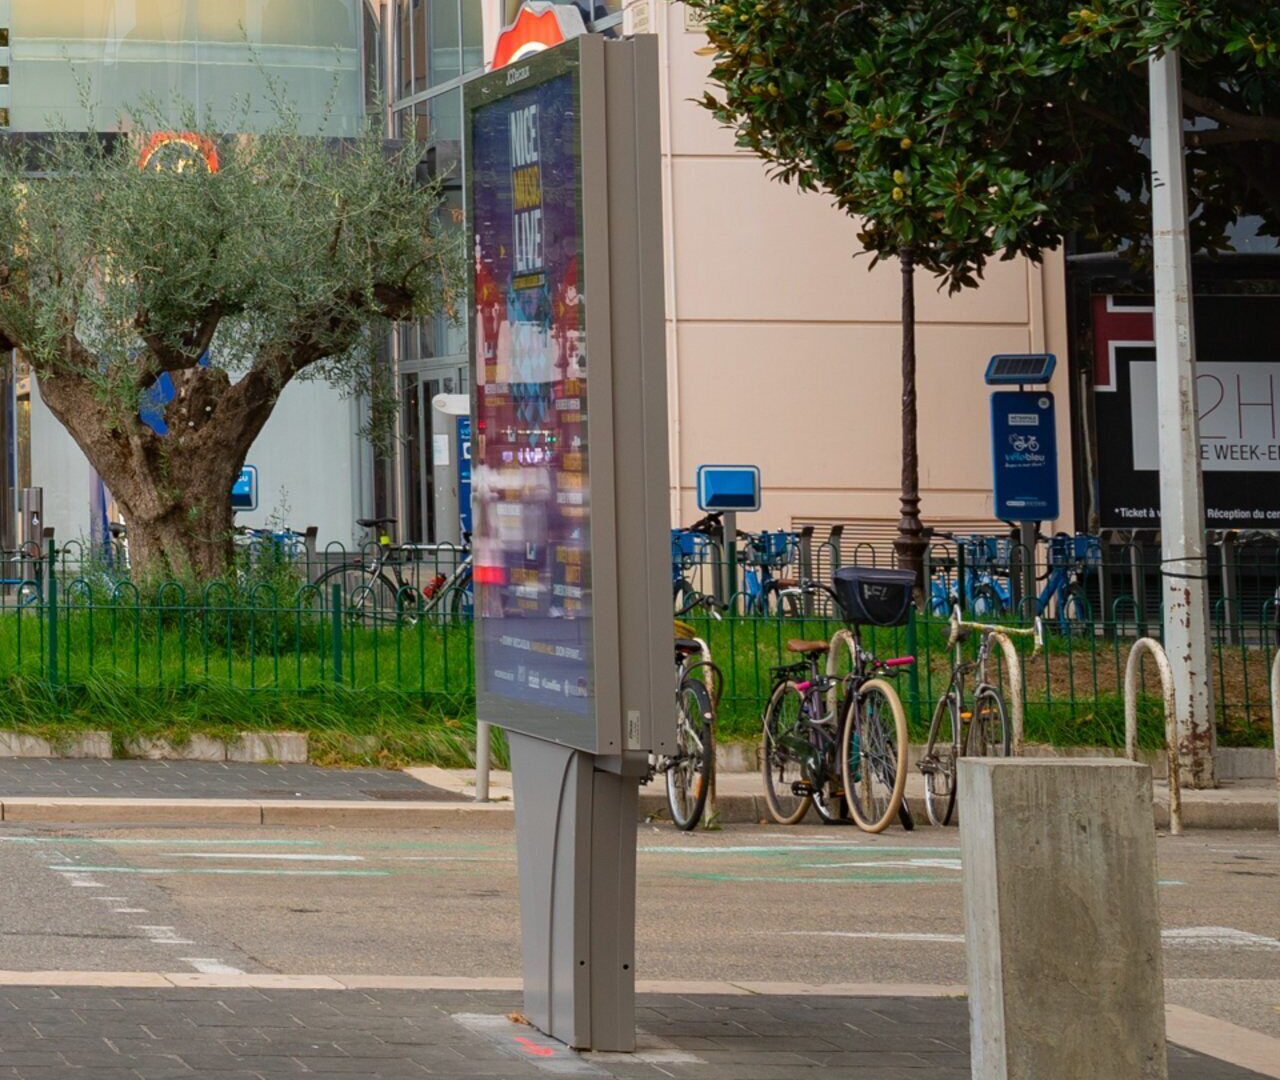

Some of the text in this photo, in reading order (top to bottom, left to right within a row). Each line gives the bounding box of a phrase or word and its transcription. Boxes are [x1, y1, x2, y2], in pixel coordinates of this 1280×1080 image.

[509, 102, 539, 169] NICE
[514, 207, 542, 272] LIVE
[1207, 508, 1251, 520] Réception
[1253, 508, 1264, 518] du
